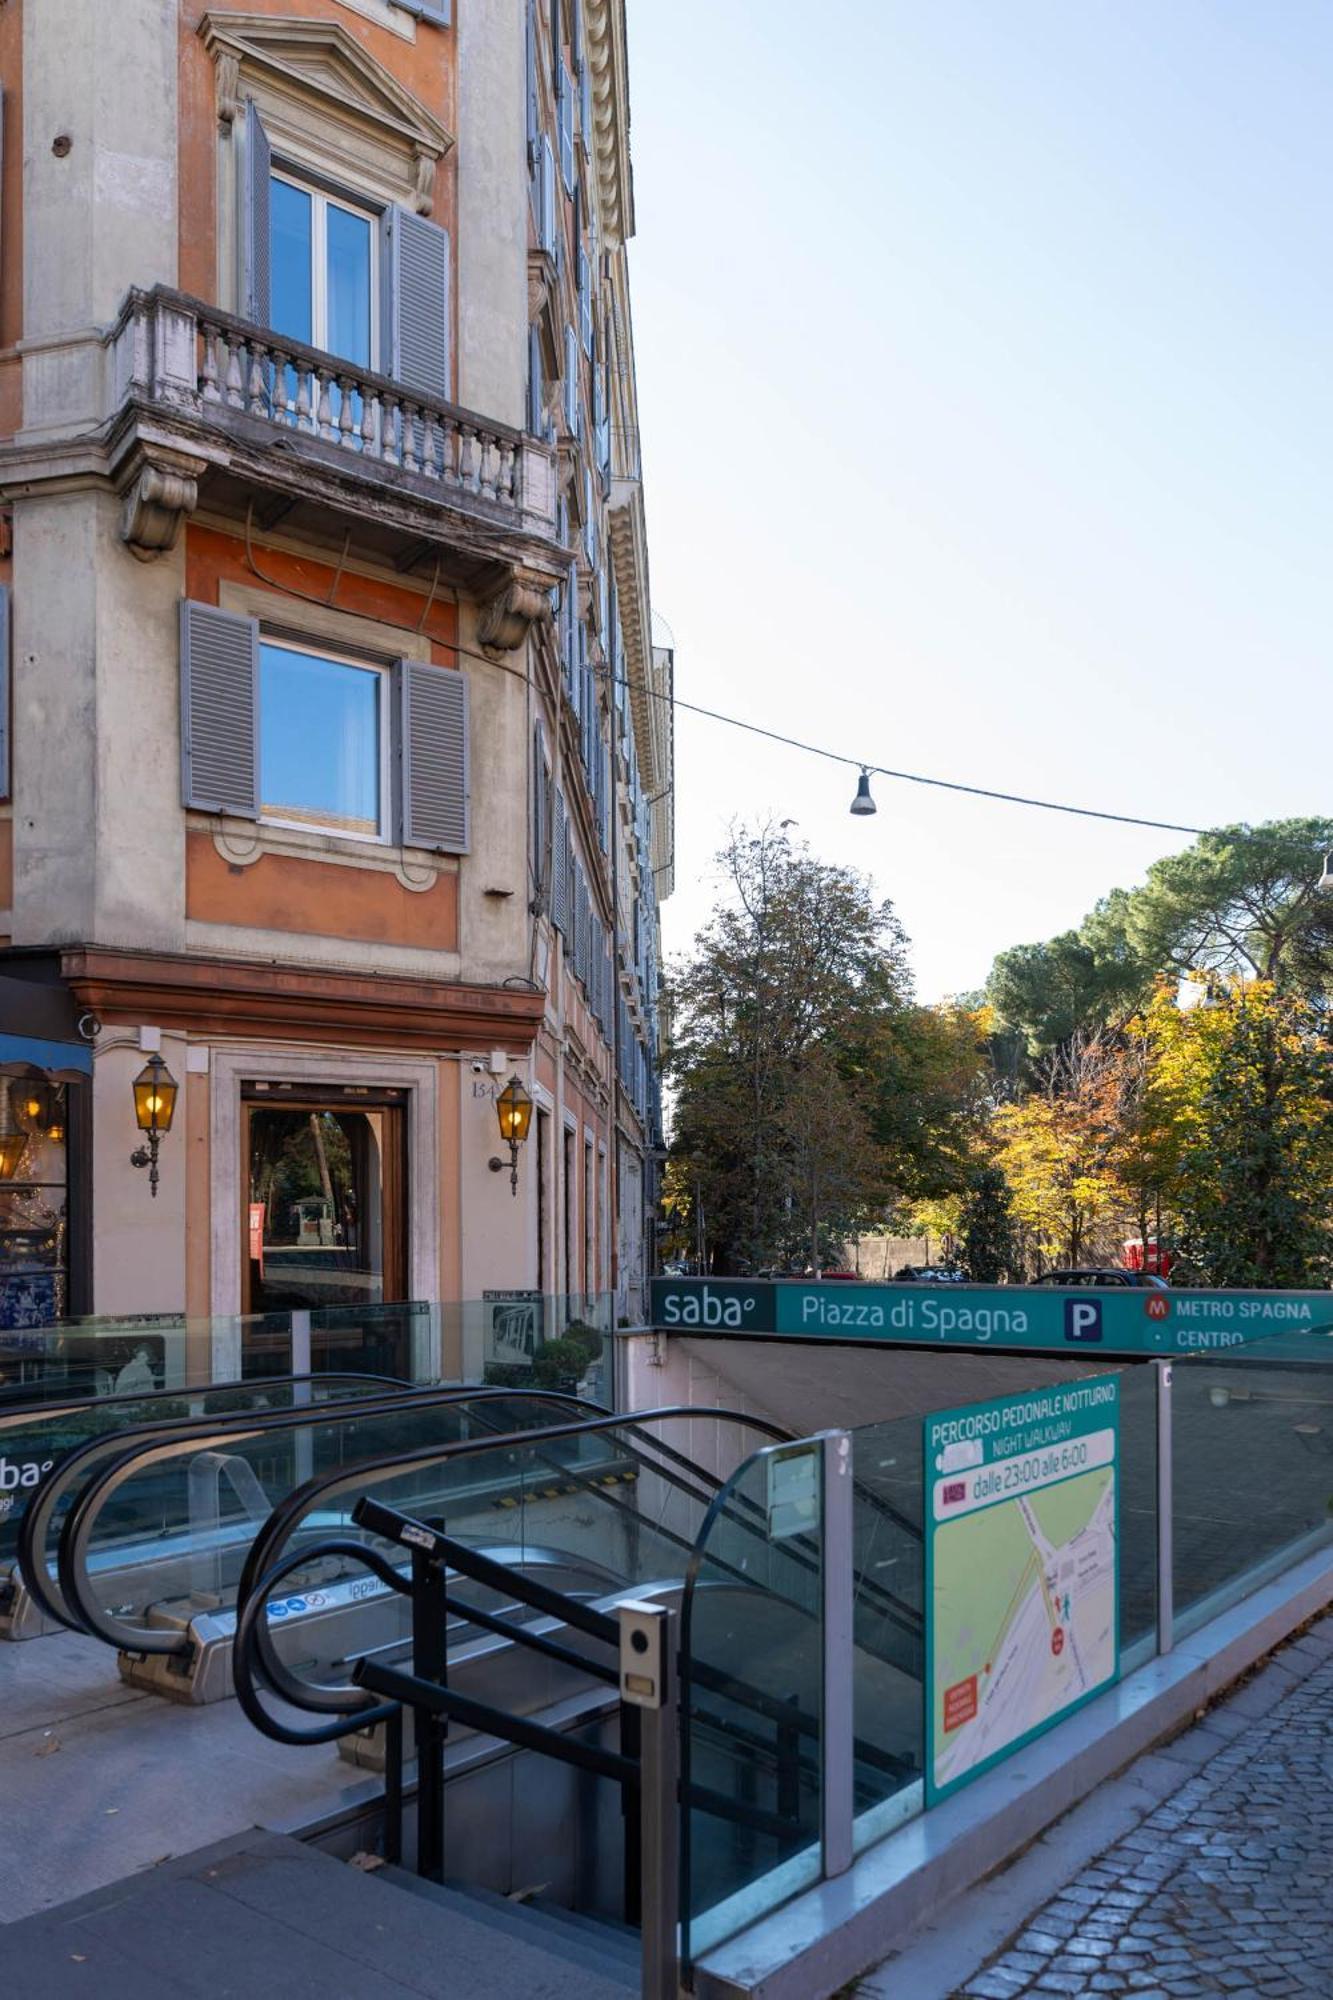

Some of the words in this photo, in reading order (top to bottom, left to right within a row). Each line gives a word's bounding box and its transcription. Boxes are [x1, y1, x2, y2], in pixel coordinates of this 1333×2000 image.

[802, 1295, 884, 1327] Piazza
[890, 1299, 915, 1328] di
[921, 1299, 1028, 1341] Spagna
[1072, 1303, 1097, 1337] P
[1176, 1301, 1234, 1319] METRO
[1239, 1302, 1312, 1320] SPAGNA
[1177, 1330, 1244, 1347] CENTRO
[932, 1411, 1000, 1447] PERCORSO
[1002, 1395, 1062, 1429] PEDONALE
[1063, 1383, 1116, 1412] NOTTURNO
[992, 1433, 1022, 1457] NIGHT
[1024, 1420, 1072, 1450] WALKWAY
[973, 1473, 1001, 1500] dalle
[1004, 1459, 1041, 1490] 23:00
[1042, 1451, 1059, 1477] alle
[1061, 1443, 1087, 1470] 6:00
